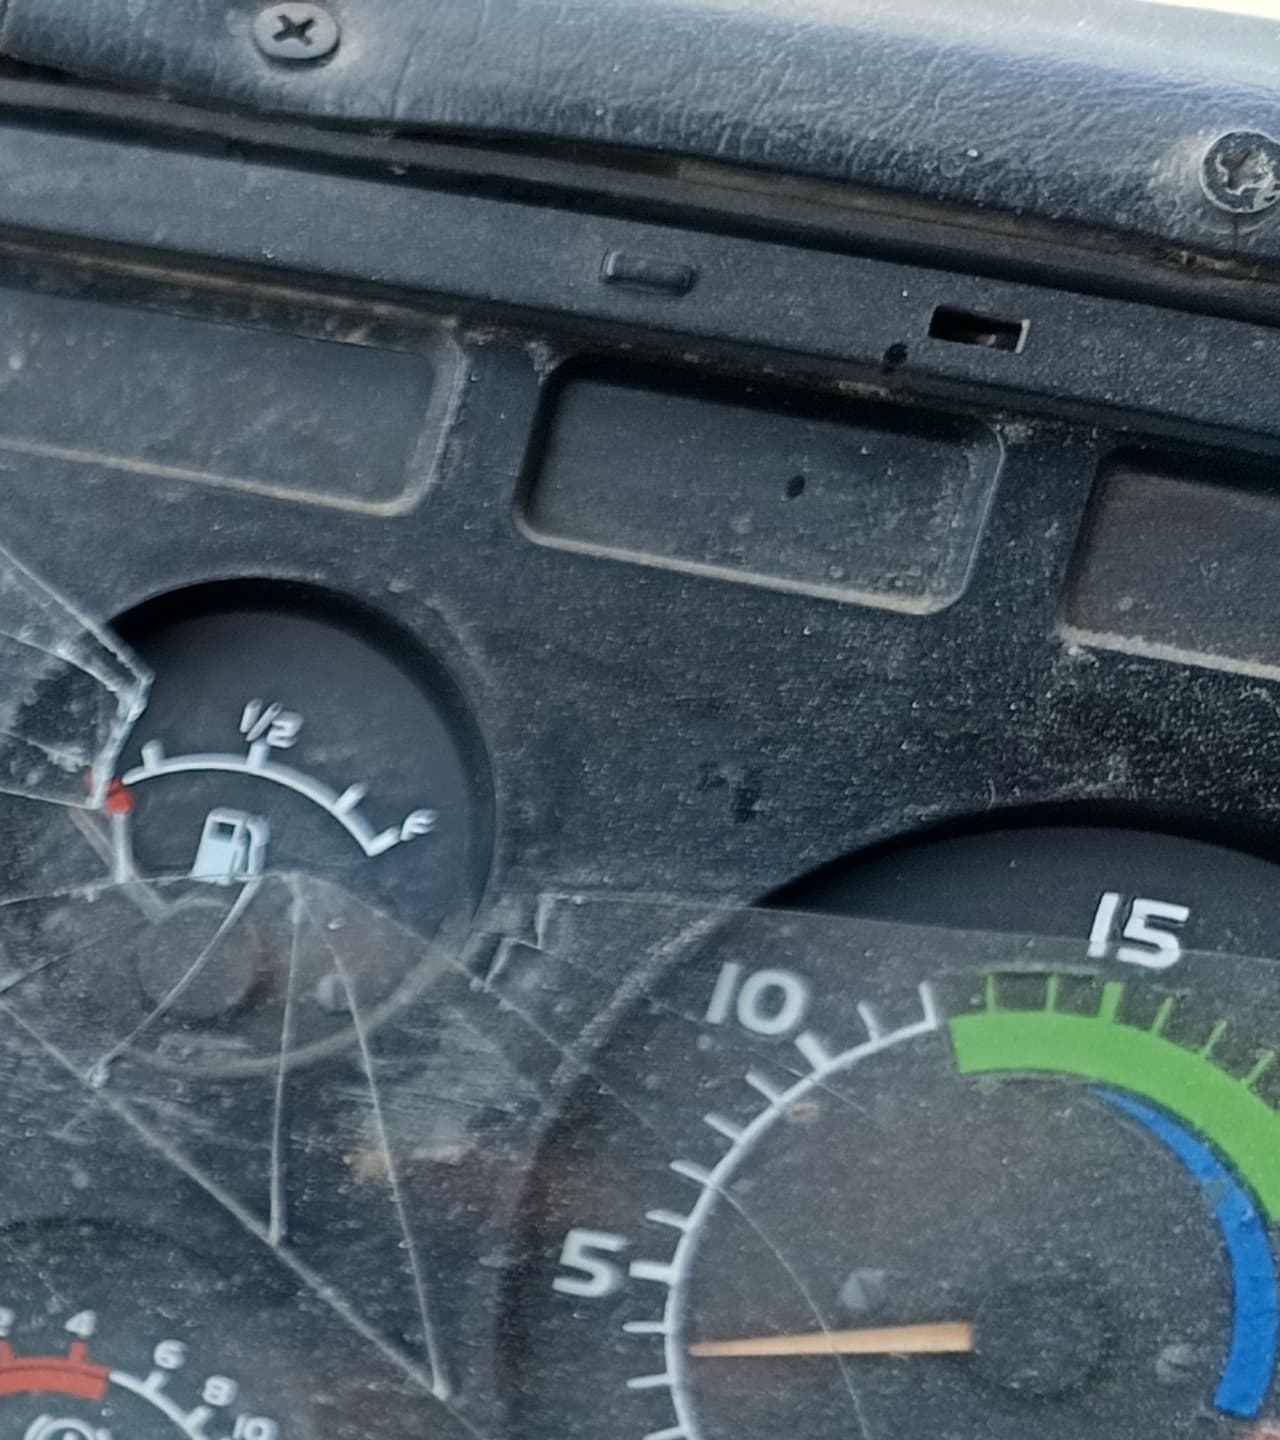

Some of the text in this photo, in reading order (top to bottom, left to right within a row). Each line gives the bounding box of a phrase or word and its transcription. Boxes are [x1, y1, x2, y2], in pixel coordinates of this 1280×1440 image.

[239, 699, 304, 748] 1/2
[1086, 891, 1191, 970] 15
[705, 961, 814, 1038] 10
[552, 1227, 628, 1299] 5
[64, 1309, 98, 1338] 4
[153, 1339, 188, 1370] 6
[202, 1375, 238, 1407] 8
